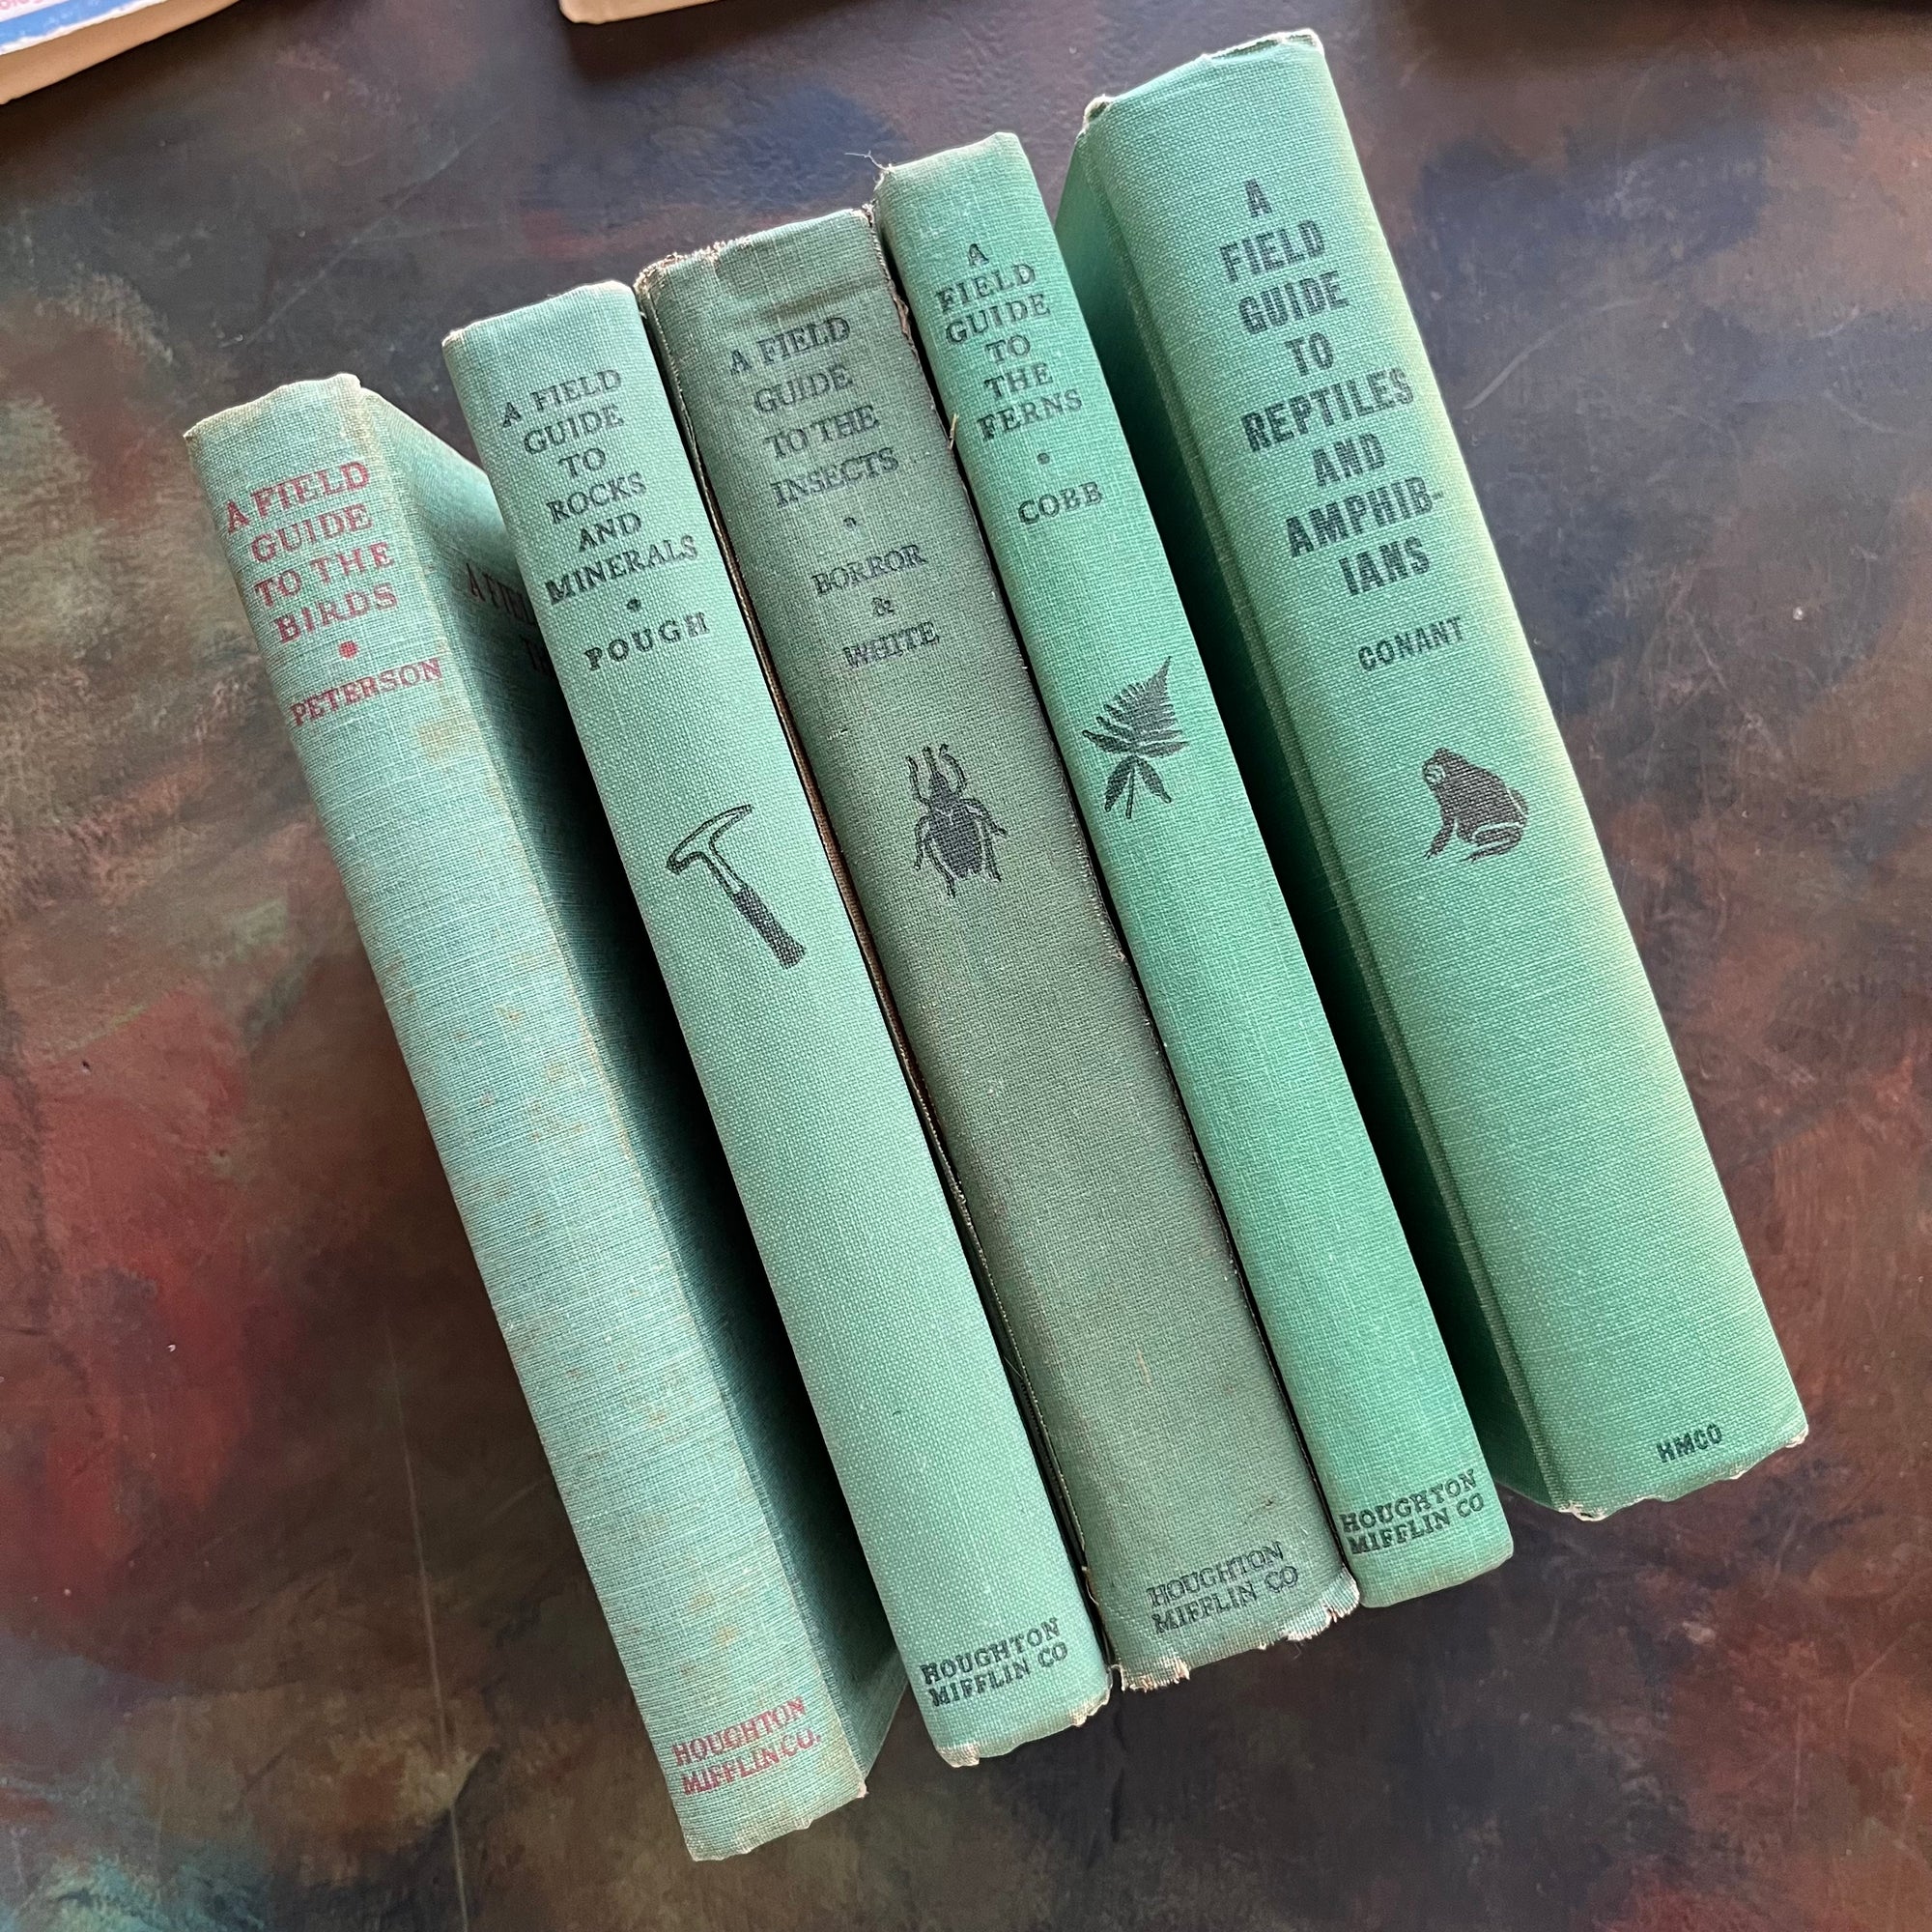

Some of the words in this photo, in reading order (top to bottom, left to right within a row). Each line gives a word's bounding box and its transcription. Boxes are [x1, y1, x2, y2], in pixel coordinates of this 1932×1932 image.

[1245, 180, 1272, 218] A
[969, 243, 989, 266] A
[1219, 220, 1326, 283] FIELD
[935, 263, 1036, 314] FIELD
[1237, 270, 1349, 335] GUIDE
[729, 350, 752, 376] A
[757, 317, 850, 364] FIELD
[946, 294, 1050, 344] GUIDE
[986, 334, 1031, 364] TO
[1285, 332, 1334, 377] TO
[502, 402, 522, 427] A
[531, 369, 621, 412] FIELD
[753, 364, 853, 412] GUIDE
[984, 362, 1053, 400] THE
[1240, 367, 1414, 453] REPTILES
[524, 404, 624, 454] GUIDE
[764, 428, 808, 459] TO
[810, 406, 879, 441] THE
[977, 389, 1082, 441] FERNS
[558, 448, 606, 478] TO
[772, 447, 899, 508] INSECTS
[1311, 433, 1385, 487] AND
[226, 501, 249, 533] A
[250, 461, 369, 519] FIELD
[546, 471, 647, 524] ROCKS
[1018, 482, 1103, 525] COBB
[1285, 476, 1443, 557] AMPHIB-
[251, 503, 373, 562] GUIDE
[579, 512, 641, 552] AND
[254, 569, 300, 608] TO
[311, 542, 393, 583] THE
[545, 535, 698, 605] MINERALS
[811, 544, 927, 597] BORROR
[1339, 536, 1431, 596] IANS
[273, 582, 397, 643] BIRDS
[482, 572, 534, 626] FIEL
[871, 597, 895, 617] &
[584, 611, 710, 671] POUGH
[842, 621, 940, 669] WHITE
[1358, 616, 1466, 671] CONANT
[291, 658, 441, 725] PETERSON
[1656, 1424, 1722, 1463] HMCO
[1339, 1469, 1478, 1533] HOUGHTON
[1347, 1507, 1453, 1554] MIFFLIN
[1457, 1493, 1485, 1519] CO
[1147, 1541, 1284, 1607] HOUGHTON
[1151, 1580, 1257, 1634] MIFFLIN
[1264, 1565, 1298, 1593] CO
[920, 1616, 1061, 1685] HOUGHTON
[928, 1659, 1031, 1707] MIFFLIN
[1037, 1642, 1068, 1668] CO
[671, 1695, 807, 1767] HOUGHTON
[680, 1747, 780, 1796] MIFFLIN
[781, 1728, 822, 1757] CO.
